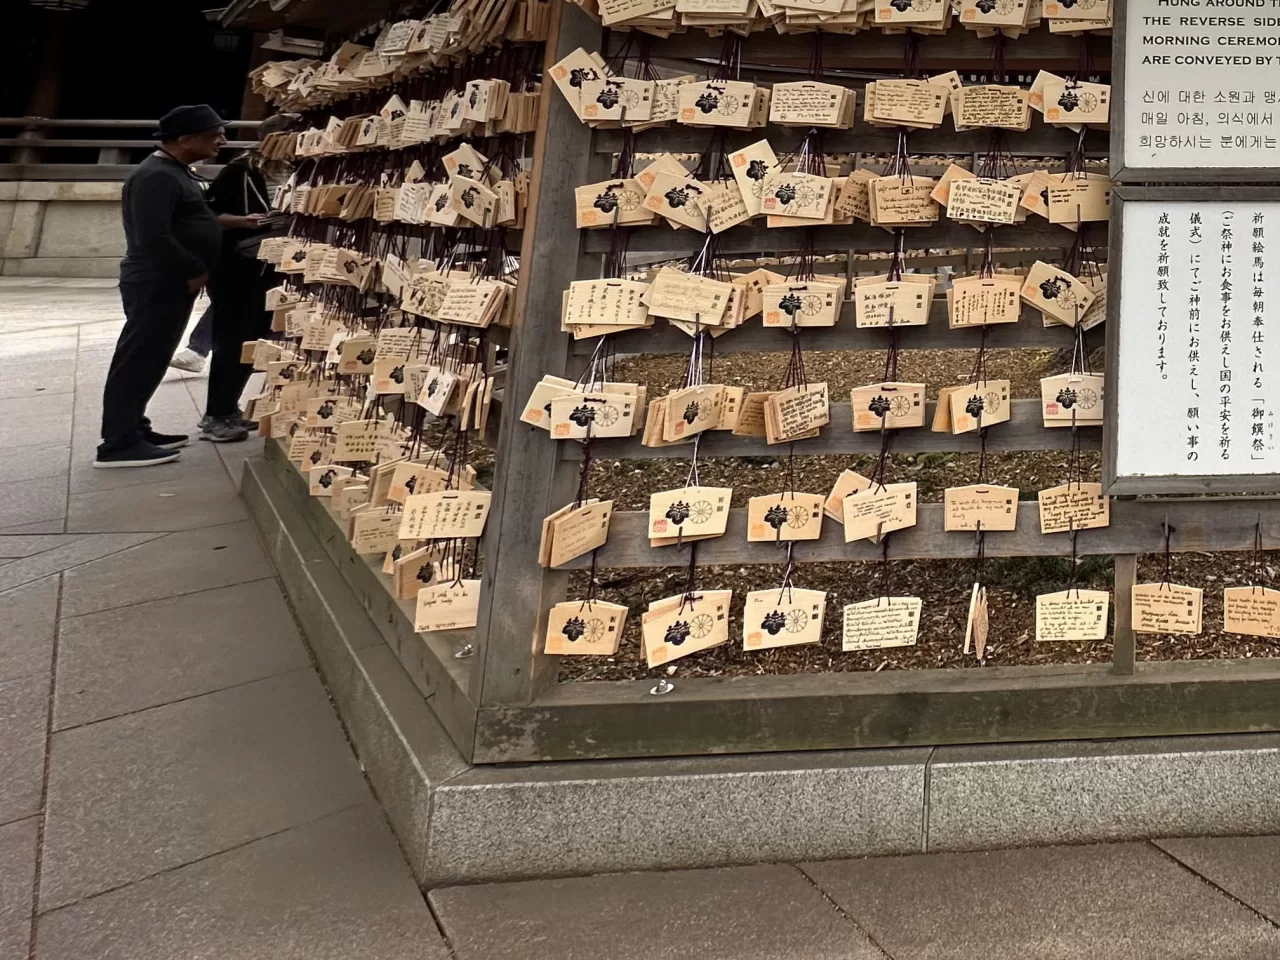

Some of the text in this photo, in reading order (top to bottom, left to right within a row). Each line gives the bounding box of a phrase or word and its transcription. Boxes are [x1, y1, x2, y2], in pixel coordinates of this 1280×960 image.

[1142, 16, 1172, 26] THE
[1179, 16, 1246, 27] REVERSE
[1142, 35, 1211, 46] MORNING
[1141, 55, 1172, 65] ARE
[1174, 55, 1252, 66] CONVEYED
[1255, 55, 1274, 66] BY
[1142, 90, 1170, 104] 신에
[1178, 90, 1207, 104] 대한
[1213, 90, 1256, 105] 소원과
[1141, 111, 1168, 126] 매일
[1177, 111, 1209, 127] 아침,
[1216, 111, 1273, 126] 의식에서
[1139, 134, 1213, 149] 희망하시는
[1220, 135, 1278, 149] 분에게는
[1155, 211, 1171, 380] 成就を祈願致しております。
